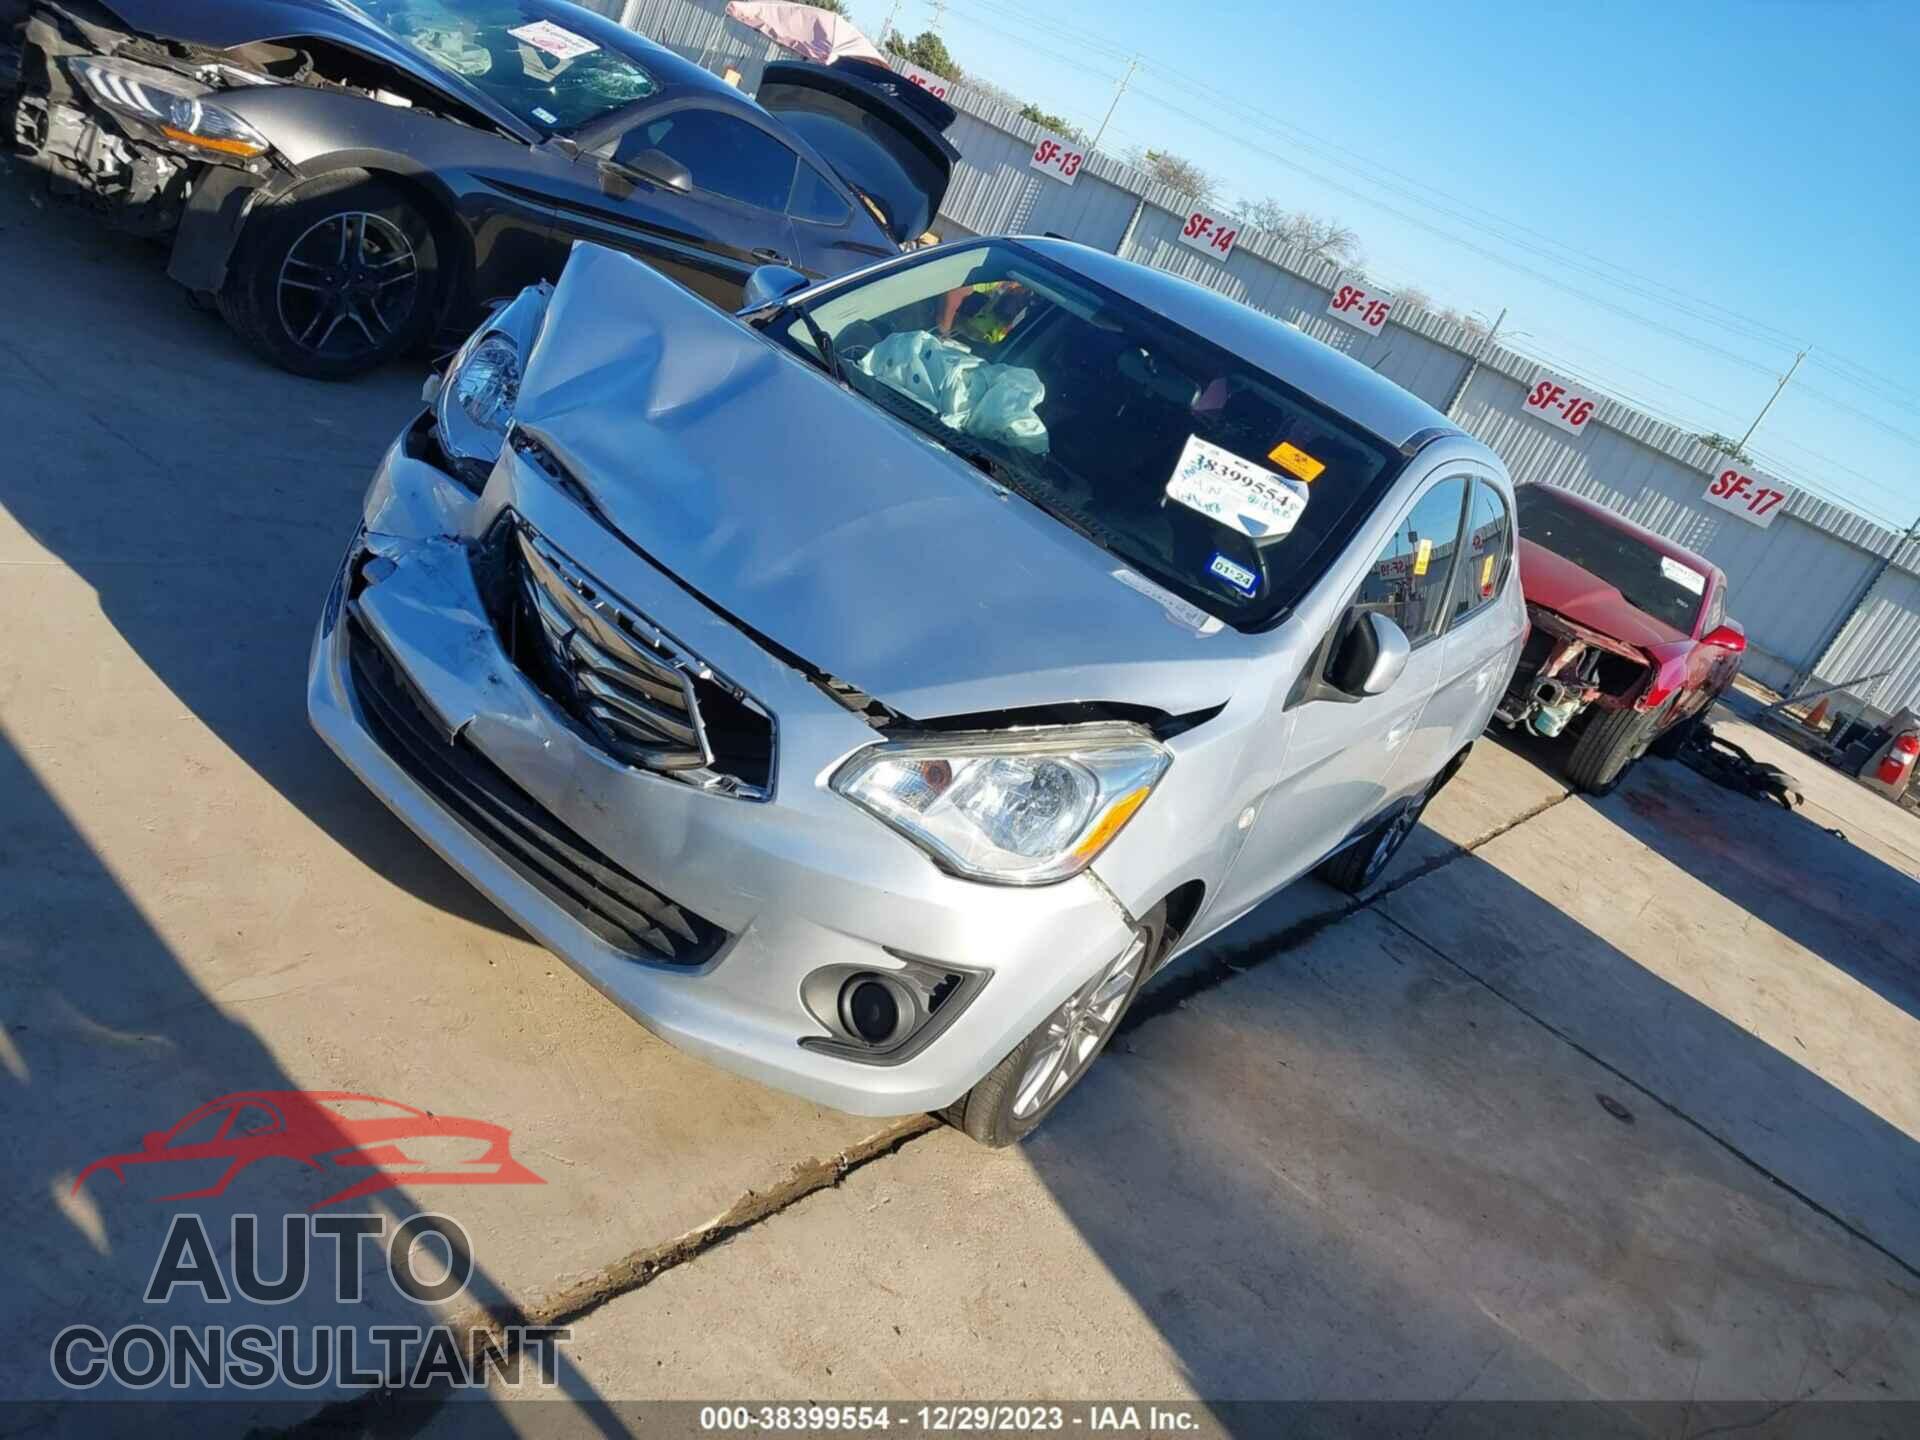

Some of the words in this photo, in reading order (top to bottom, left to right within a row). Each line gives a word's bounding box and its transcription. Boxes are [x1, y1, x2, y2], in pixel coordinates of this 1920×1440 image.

[1034, 139, 1082, 176] SF-13
[1183, 213, 1236, 252] SF-14
[1331, 286, 1390, 327] SF-15
[1528, 381, 1595, 426] SF-16
[1195, 454, 1290, 507] 38399554
[1710, 470, 1785, 516] SF-17
